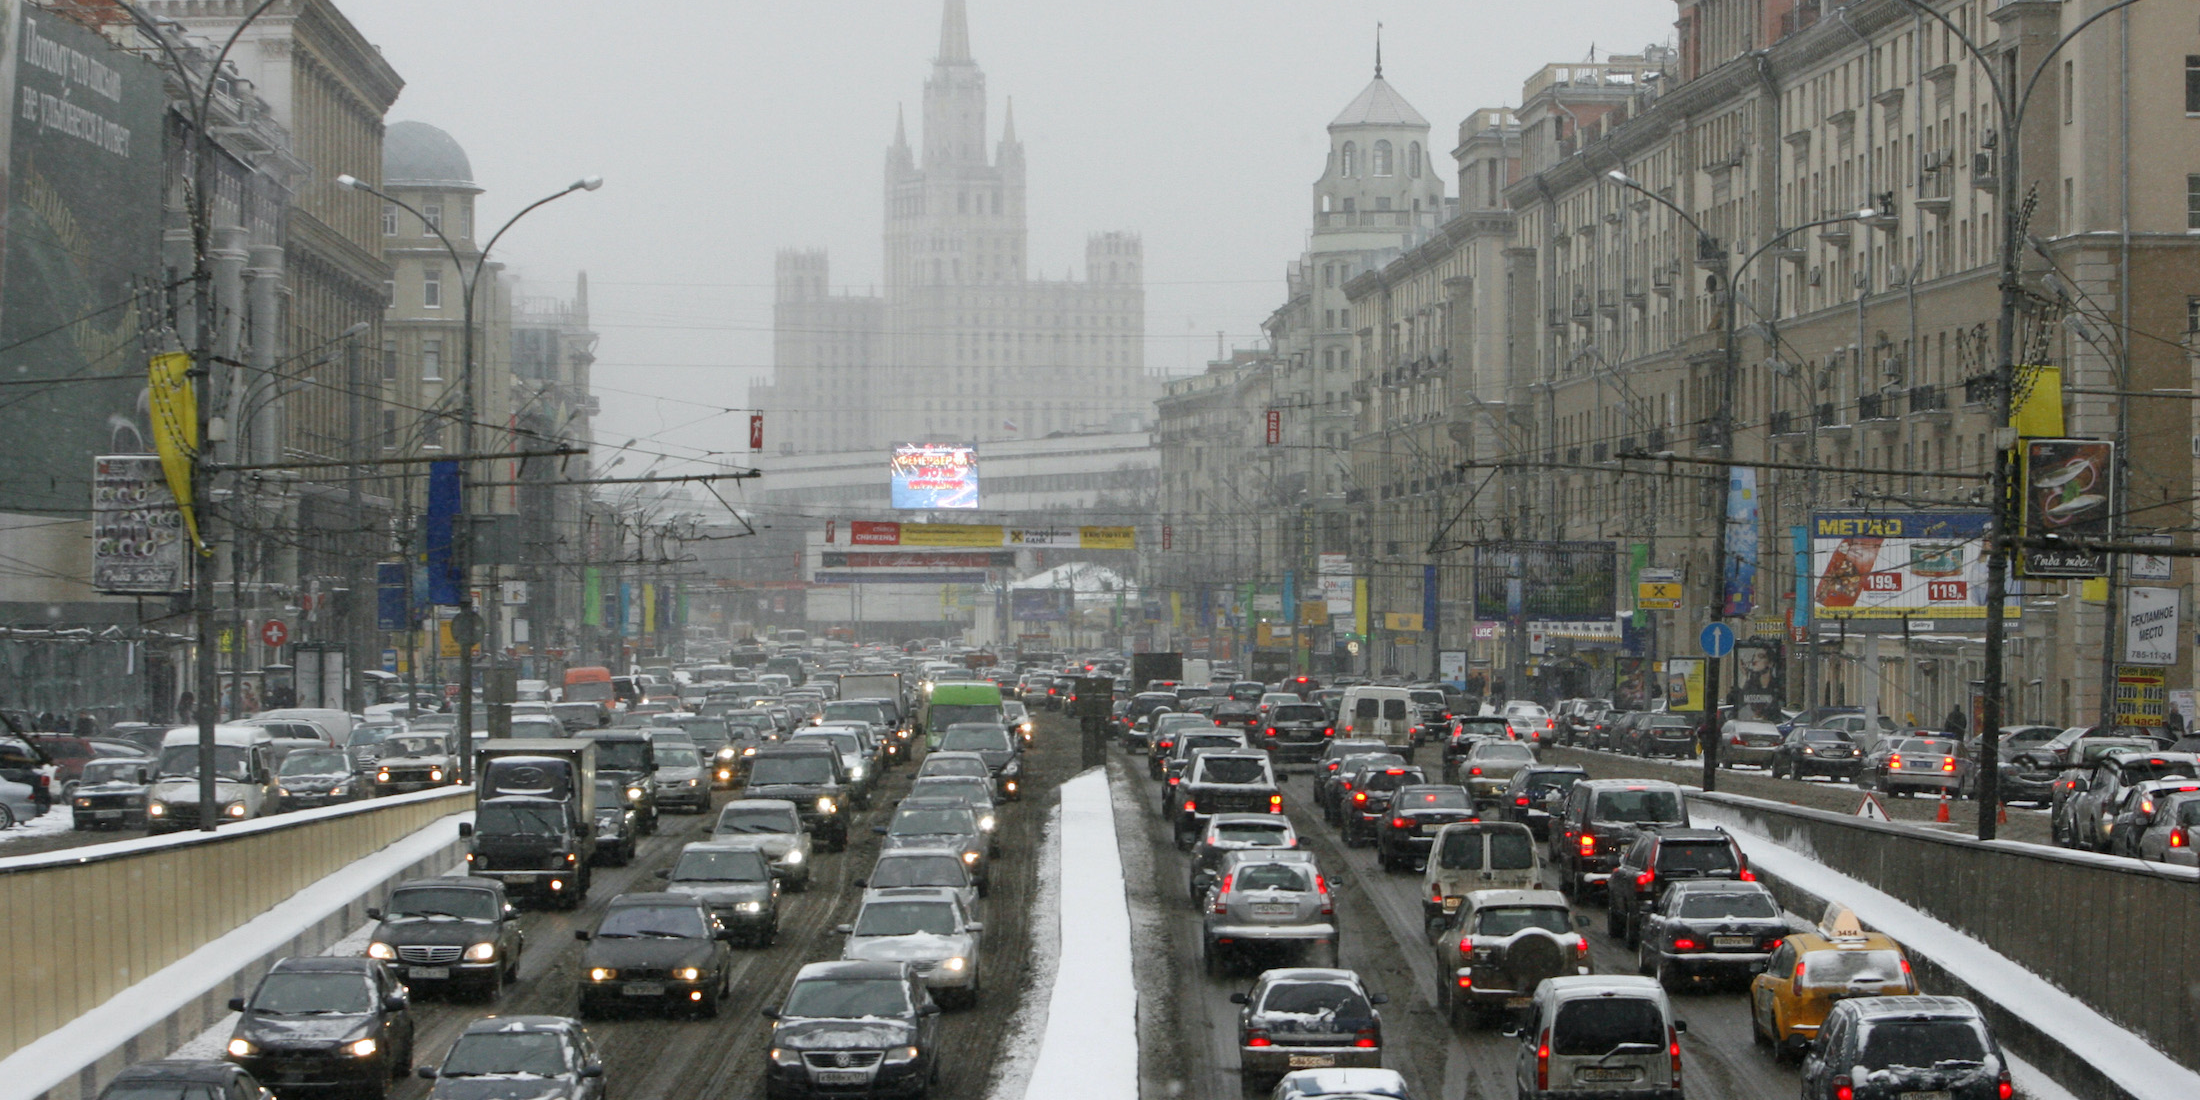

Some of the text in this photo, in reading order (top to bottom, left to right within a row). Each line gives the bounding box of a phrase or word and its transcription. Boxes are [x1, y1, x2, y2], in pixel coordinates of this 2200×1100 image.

[25, 17, 70, 87] Потому
[71, 49, 88, 86] что
[22, 86, 38, 122] не
[1818, 519, 1903, 536] METRO
[2033, 552, 2060, 566] Рыба
[2131, 606, 2174, 628] РЕКЛАМНОЕ
[2139, 625, 2164, 642] МЕСТО
[2131, 650, 2172, 660] 785-11-24
[2117, 715, 2161, 727] 24 часа
